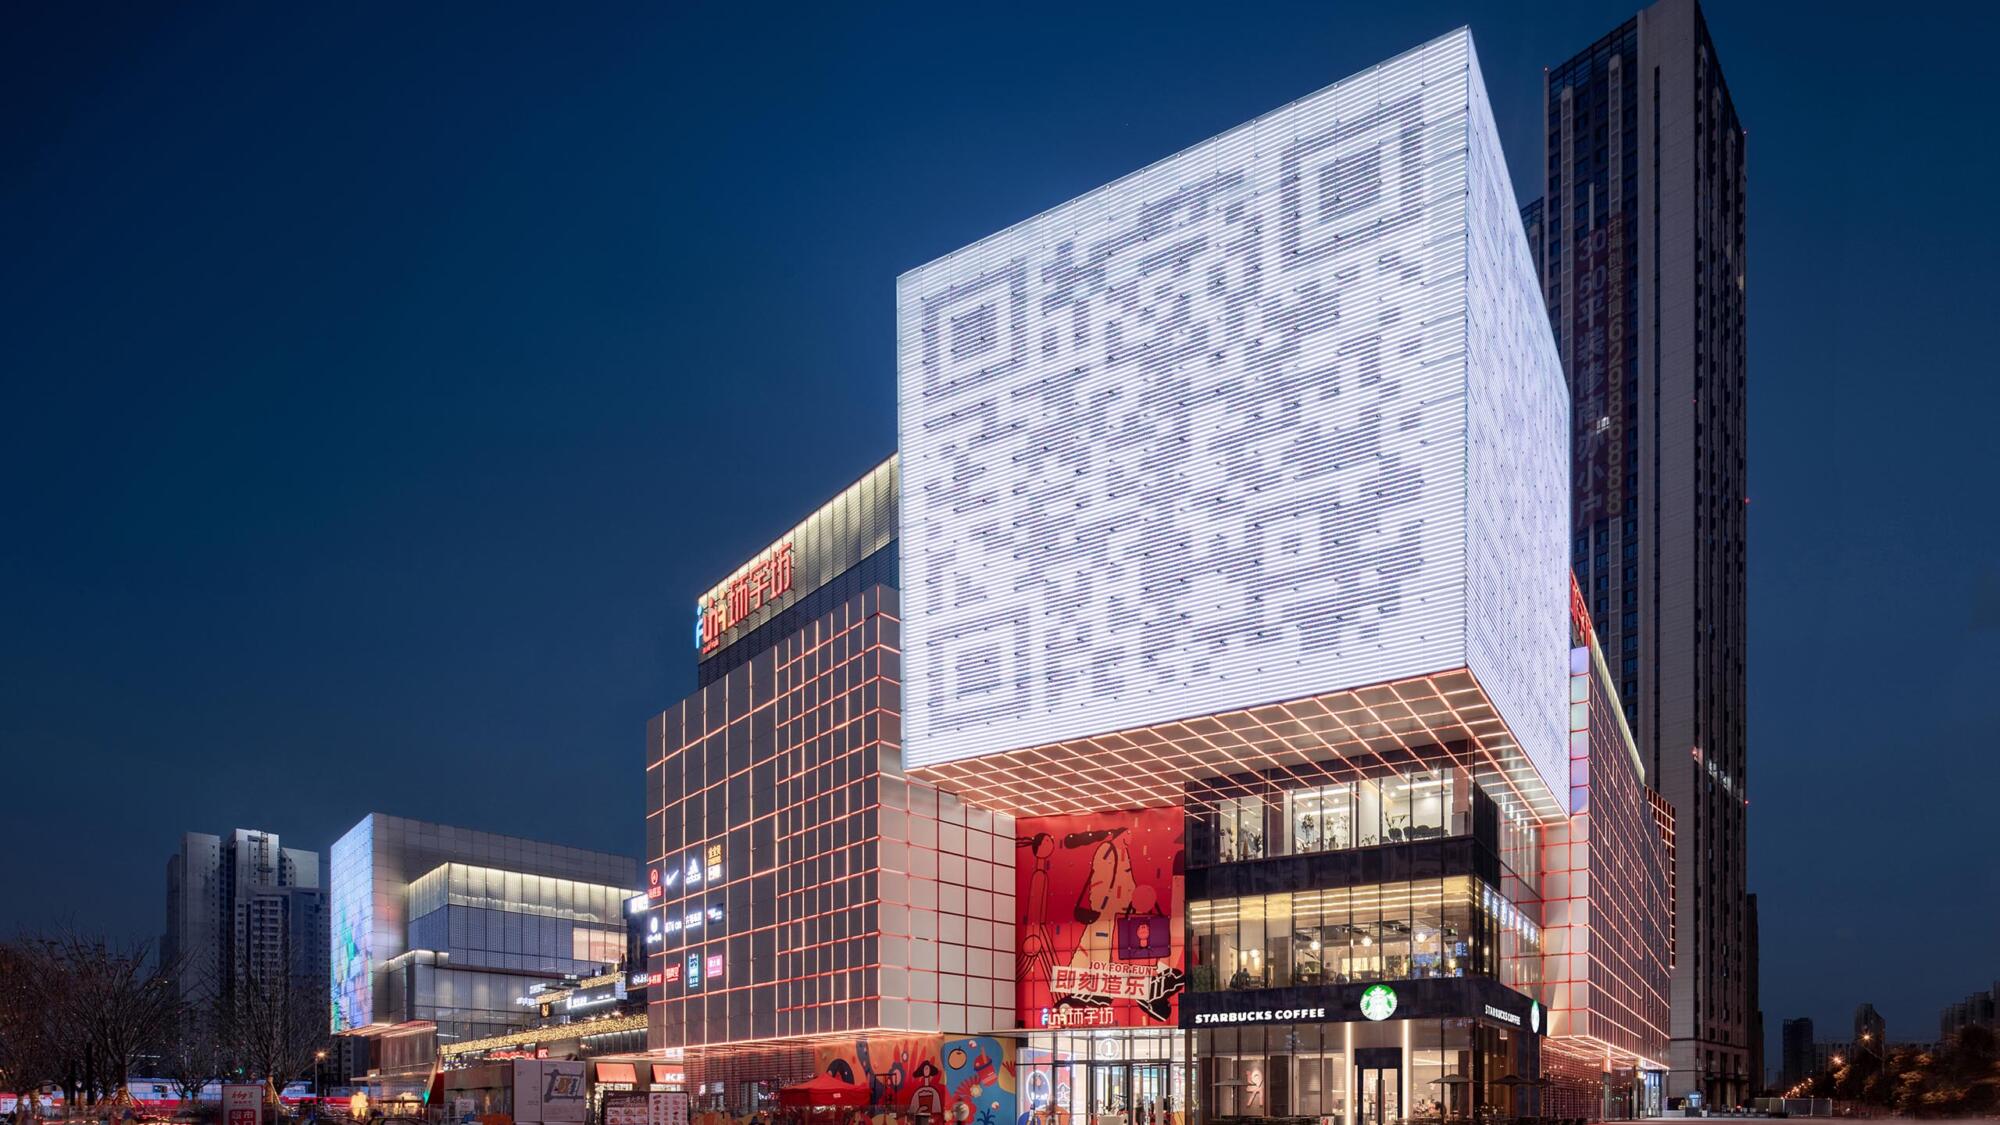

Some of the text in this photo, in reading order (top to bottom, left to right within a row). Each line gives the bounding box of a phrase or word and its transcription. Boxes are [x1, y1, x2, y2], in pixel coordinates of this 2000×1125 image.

[1089, 961, 1108, 972] JOY
[1109, 962, 1130, 975] FOR
[1055, 969, 1145, 996] 即刻造乐
[1195, 1008, 1326, 1024] STARBUCKS COFFEE
[1485, 1004, 1521, 1026] STARBUCKS COFFEE
[1105, 1041, 1113, 1056] 1
